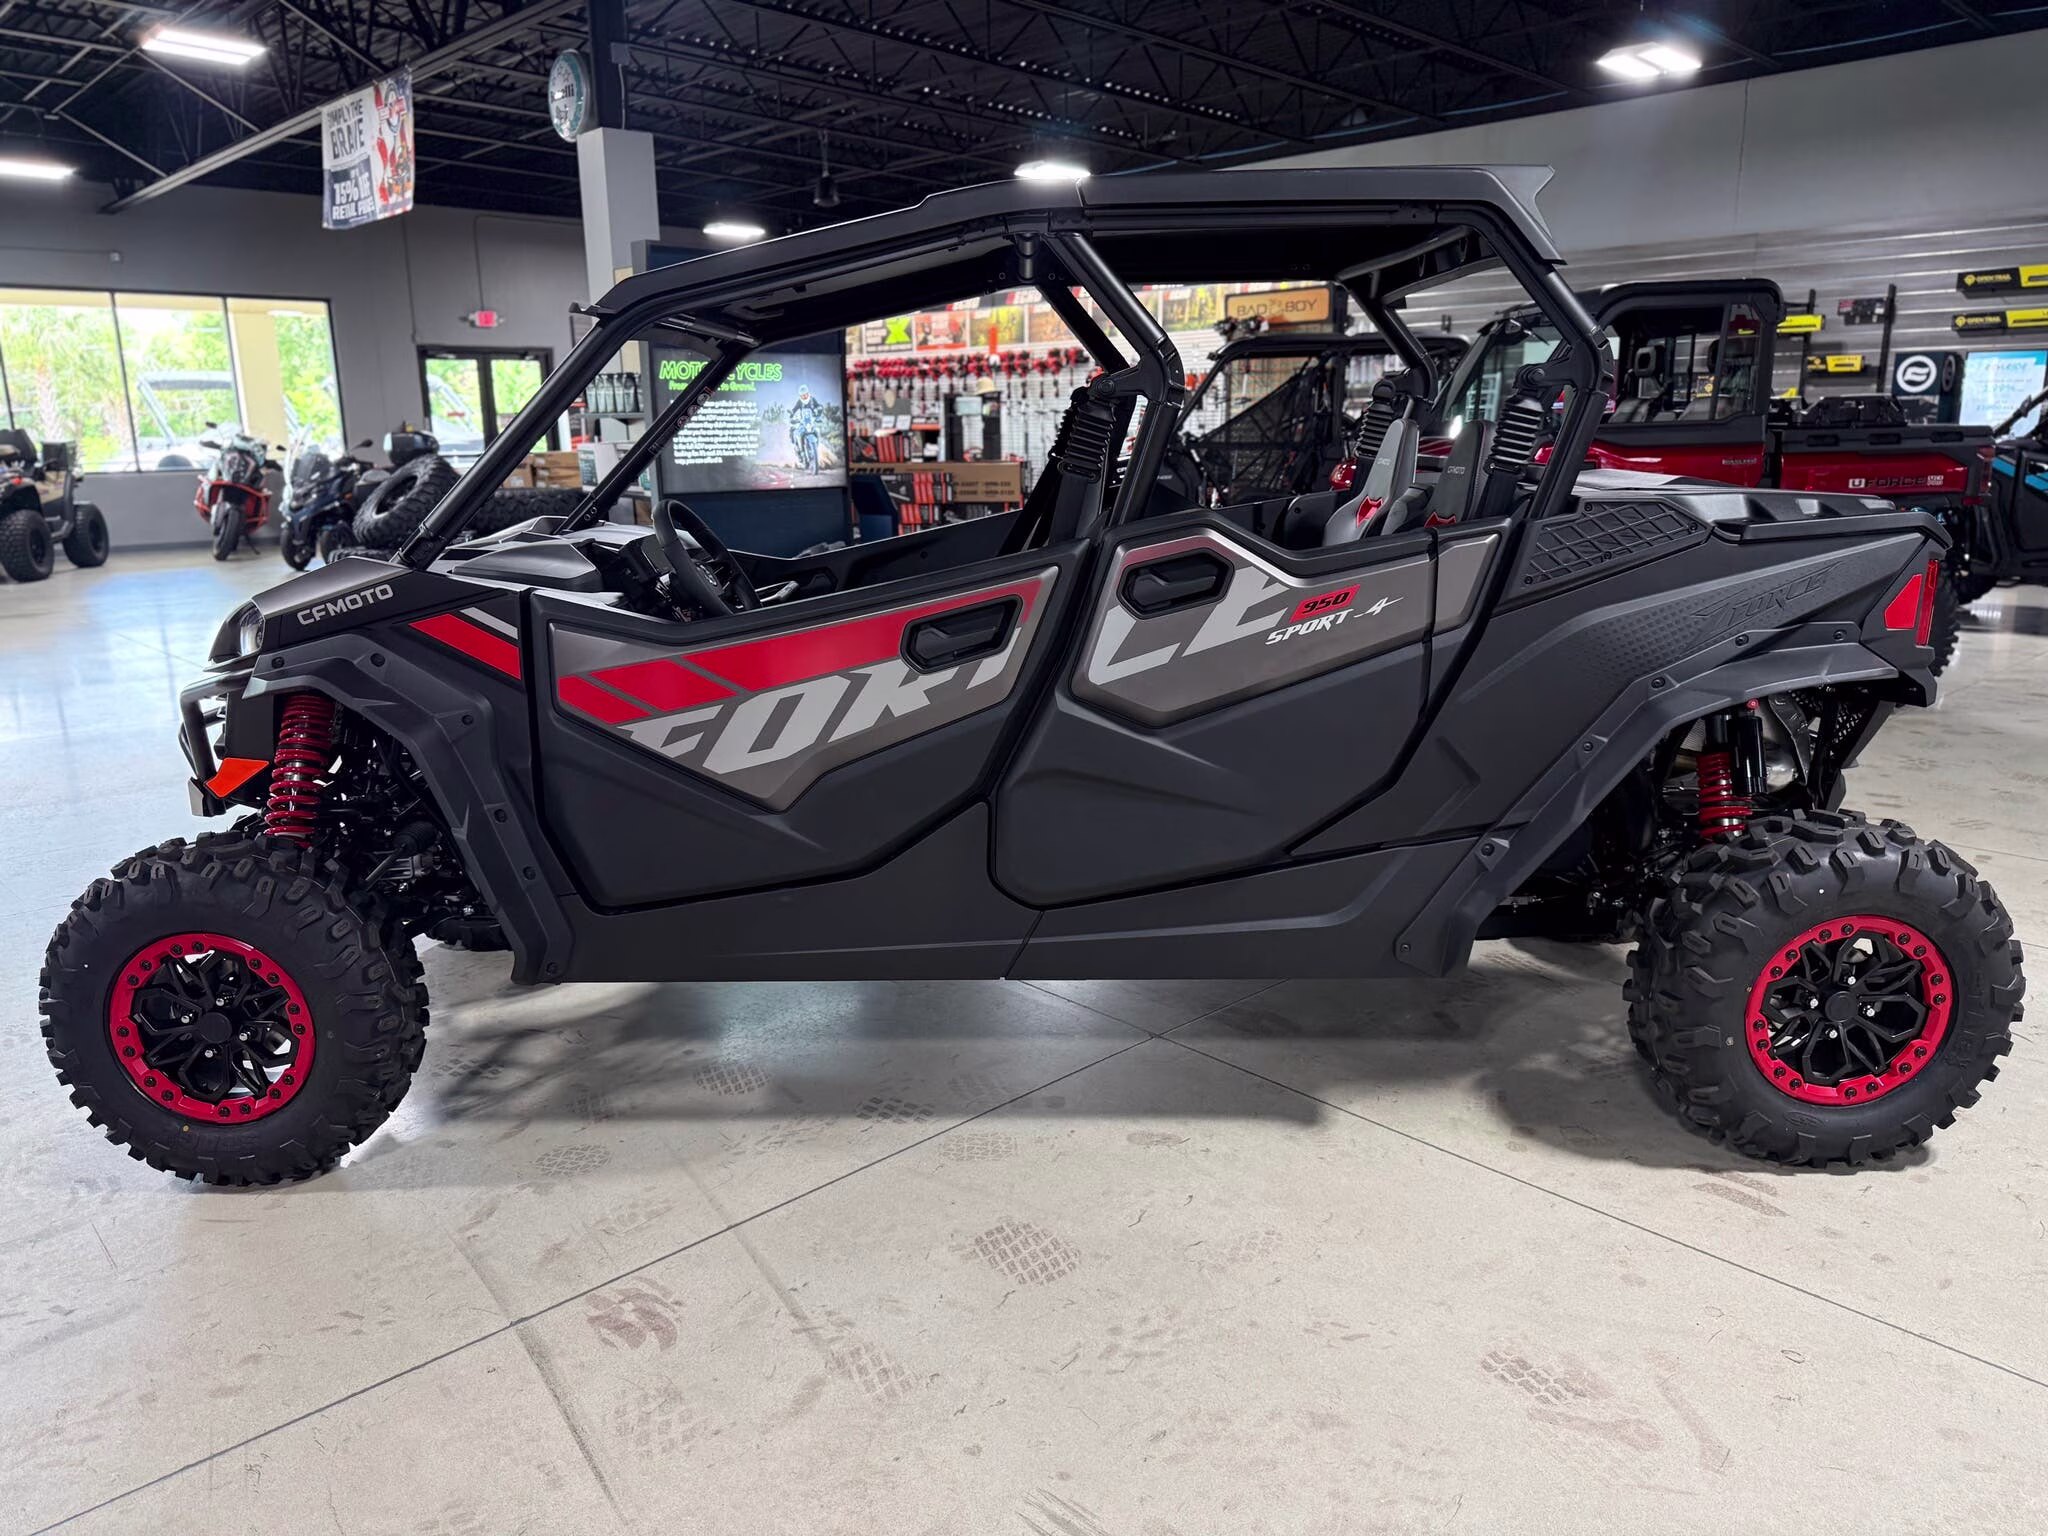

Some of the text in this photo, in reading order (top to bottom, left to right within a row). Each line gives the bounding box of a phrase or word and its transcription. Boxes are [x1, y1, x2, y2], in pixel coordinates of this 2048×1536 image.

[1237, 299, 1317, 317] BAD BOY
[659, 360, 783, 381] MOTYCLES
[297, 584, 394, 625] CFMOTO
[1301, 591, 1351, 615] 950
[1265, 608, 1355, 645] SPORT
